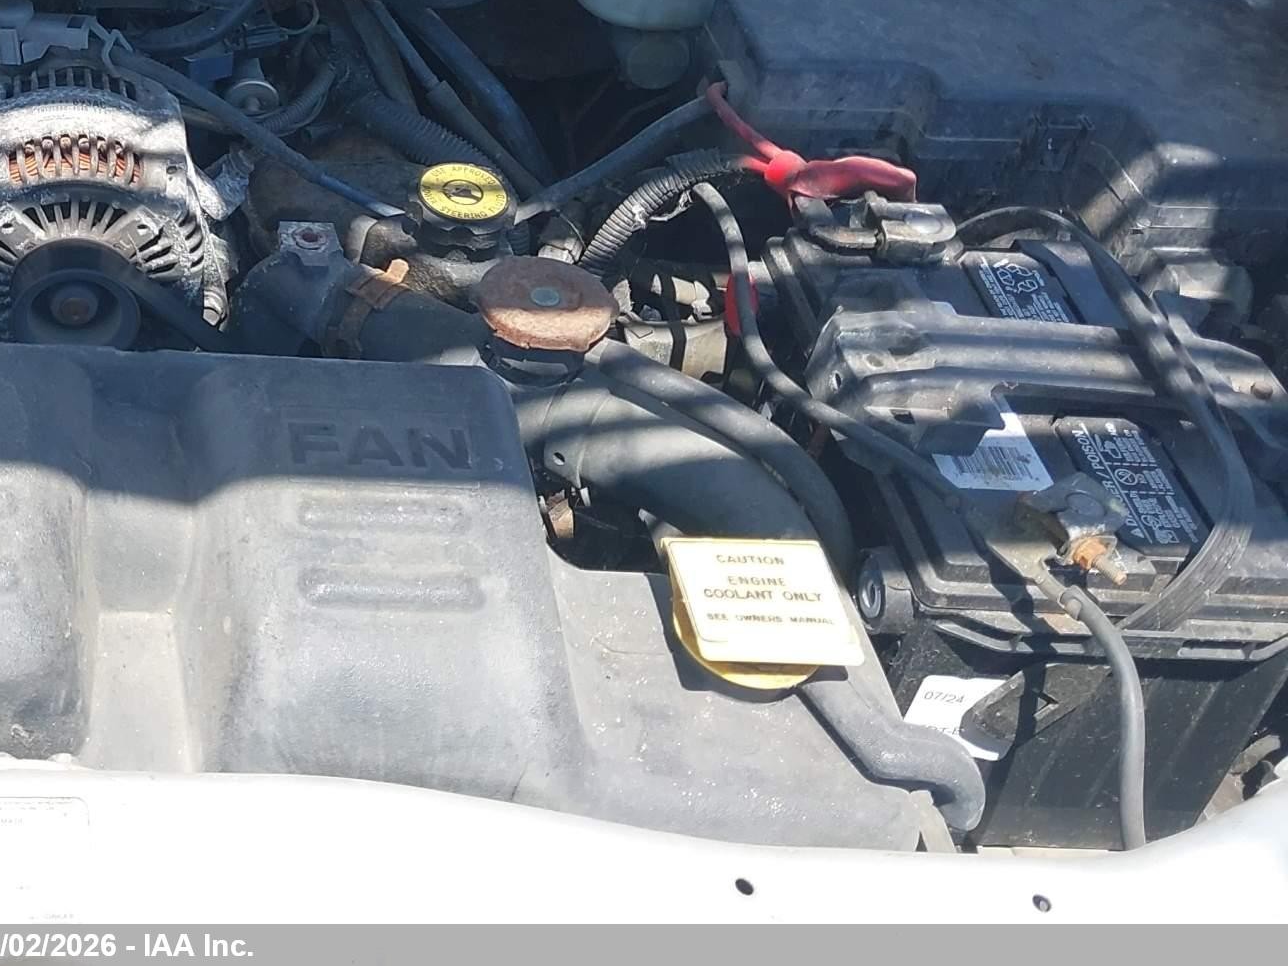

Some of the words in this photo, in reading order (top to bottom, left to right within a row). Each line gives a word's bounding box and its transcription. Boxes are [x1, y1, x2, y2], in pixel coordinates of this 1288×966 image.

[440, 206, 488, 219] STEERING
[287, 421, 472, 472] FAN
[1071, 429, 1105, 472] POISON
[715, 554, 786, 566] CAUTION
[727, 576, 787, 587] ENGINE
[703, 588, 773, 601] COOLANT
[781, 590, 823, 603] ONLY
[923, 690, 966, 705] 07/24
